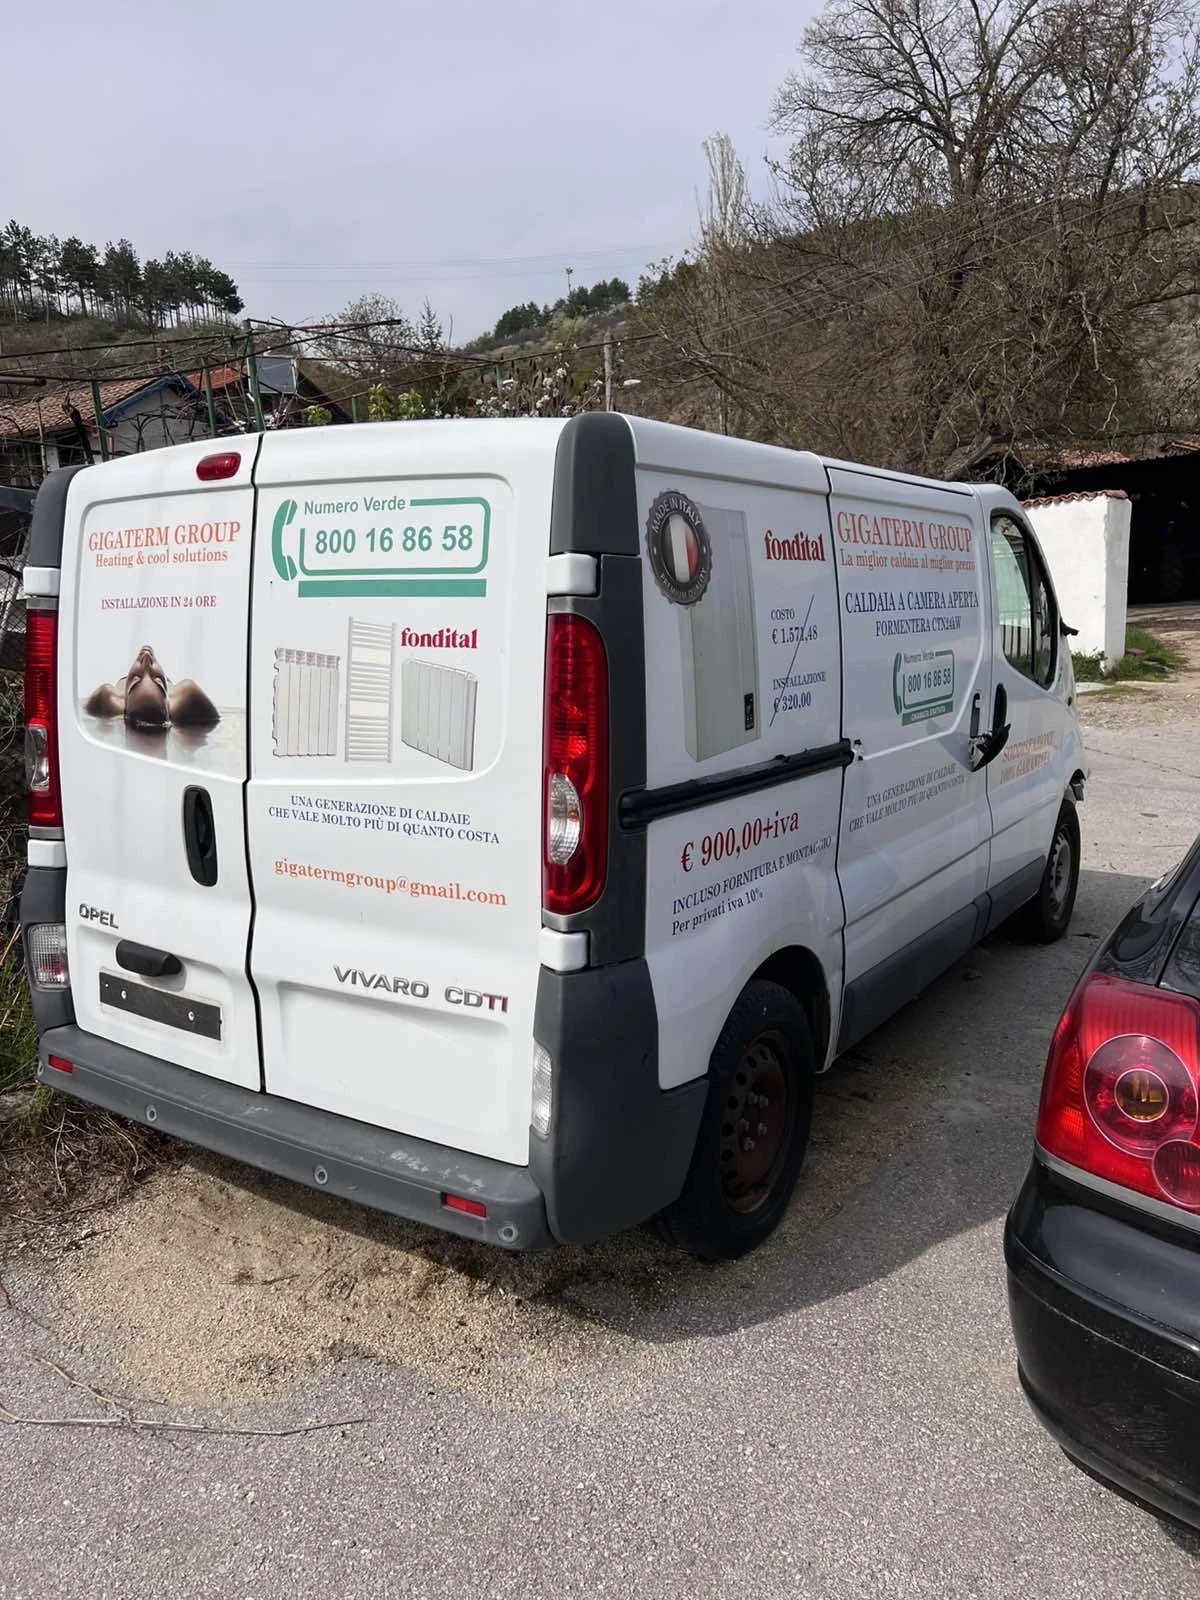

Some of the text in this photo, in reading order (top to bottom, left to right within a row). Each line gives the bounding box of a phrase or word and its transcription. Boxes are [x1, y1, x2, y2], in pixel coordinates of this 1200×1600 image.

[304, 496, 406, 515] Numero Verde
[652, 502, 670, 533] MADE
[680, 499, 703, 526] ITALY
[88, 521, 241, 551] GIGATERM GROUP
[315, 525, 473, 554] 800 16 86 58
[764, 529, 826, 561] fondital
[836, 511, 972, 552] GIGATERM GROUP
[95, 548, 228, 568] Heating & cool solutions
[840, 548, 854, 567] La
[856, 551, 888, 571] miglior
[101, 595, 217, 610] INSTALLAZIONE IN 24 ORE
[770, 608, 795, 620] COSTO
[845, 592, 979, 614] CALDAIA A CAMERA APERTA
[400, 627, 478, 649] fondital
[772, 624, 818, 644] € 1.571,48
[876, 618, 931, 637] FORMENTERA
[773, 671, 826, 690] INSTALLAZIONE
[907, 674, 921, 693] 800
[923, 671, 932, 688] 16
[933, 669, 941, 687] 86
[882, 775, 925, 802] GENERAZIONE
[291, 795, 470, 826] UNA GENERAZIONE DI CALDAIE
[849, 815, 865, 833] CHE
[269, 806, 500, 844] CHE VALE MOLTO PIÙ DI QUANTO COSTA
[681, 810, 800, 873] € 900,00+iva
[273, 858, 508, 906] gigatermgroup@gmail.com
[672, 835, 832, 915] INCLUSO FORNITURA E MONTAGGIO
[78, 903, 120, 930] OPEL
[671, 887, 764, 936] Per privati iva 10%
[333, 965, 510, 1013] VIVARO CDTI
